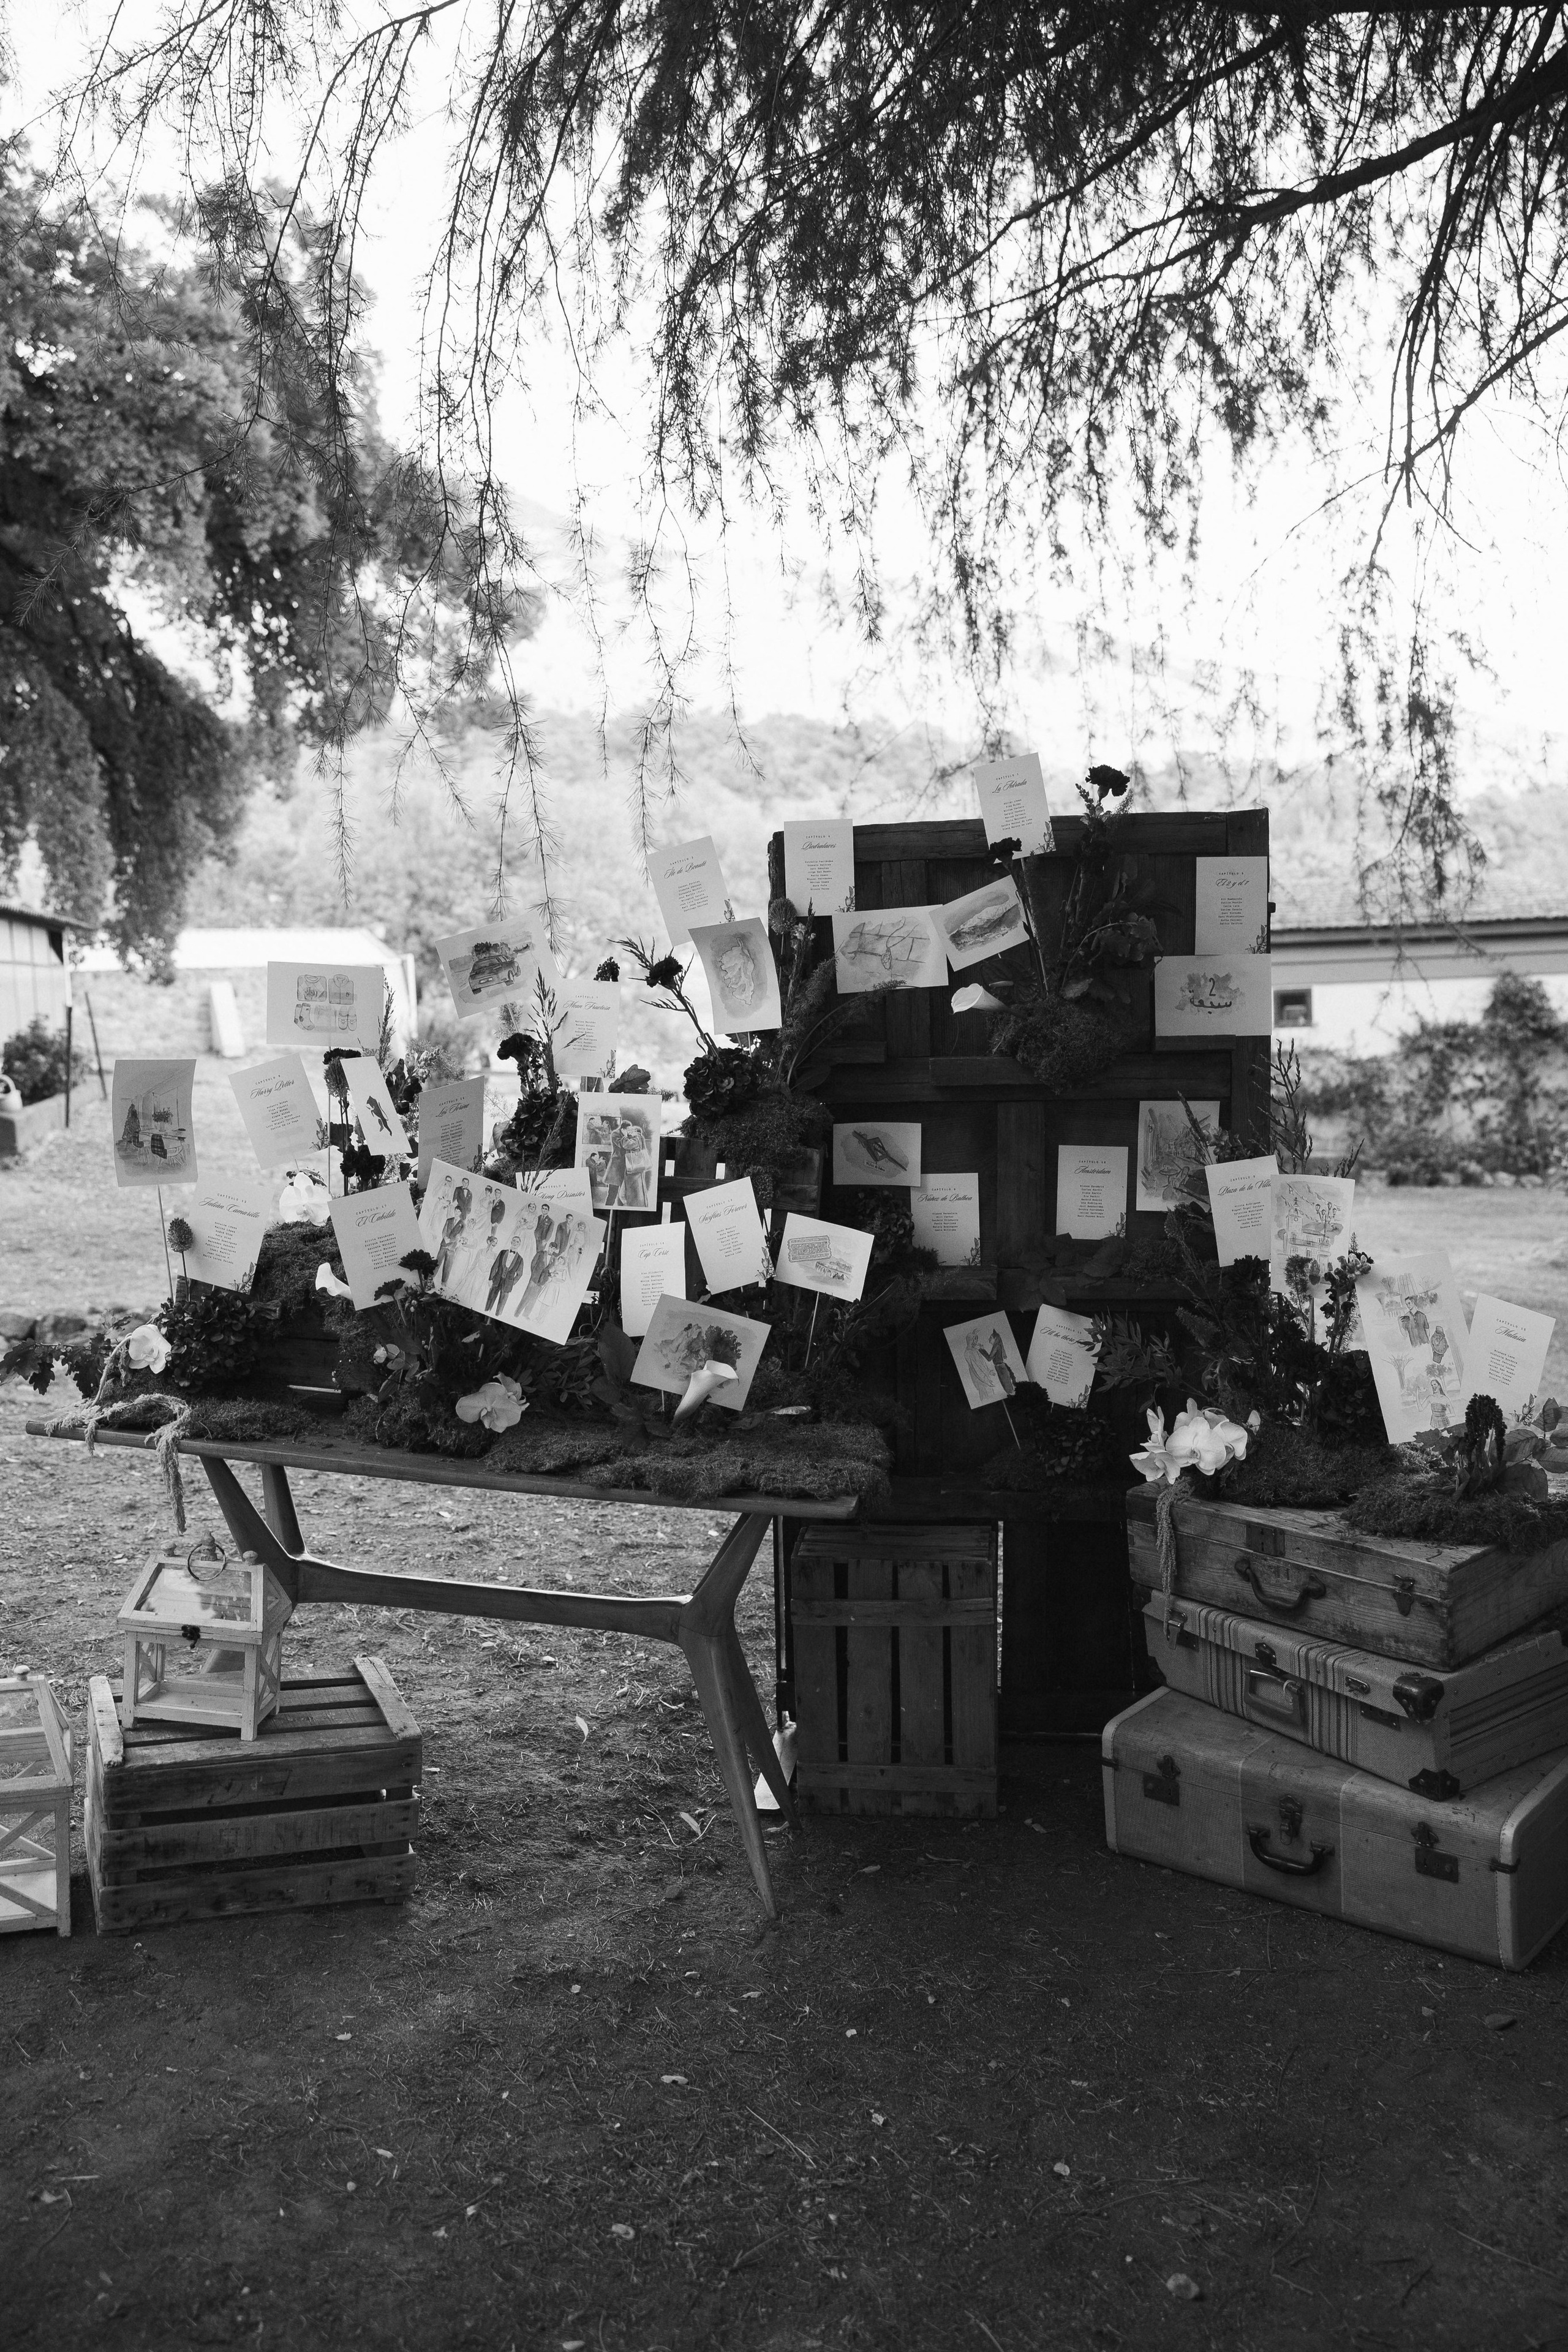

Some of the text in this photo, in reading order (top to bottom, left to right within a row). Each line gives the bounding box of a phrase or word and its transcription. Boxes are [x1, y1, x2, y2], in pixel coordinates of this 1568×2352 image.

[992, 778, 1027, 793] La Adrada
[685, 861, 706, 873] Beauté
[1208, 977, 1216, 997] 2
[584, 1001, 611, 1010] Fructosa
[251, 1080, 294, 1098] Harry Potter
[537, 1192, 554, 1201] lking
[1218, 1186, 1237, 1196] Plaza
[949, 1194, 972, 1202] Balboa
[198, 1197, 260, 1218] Julián Camarillo
[355, 1209, 396, 1227] El Cabildo
[699, 1204, 747, 1224] Swifties Forever
[638, 1248, 669, 1260] Cap Corse
[1496, 1319, 1518, 1328] CAPÍTULO
[1061, 1335, 1075, 1344] there
[1495, 1327, 1526, 1342] Malasia
